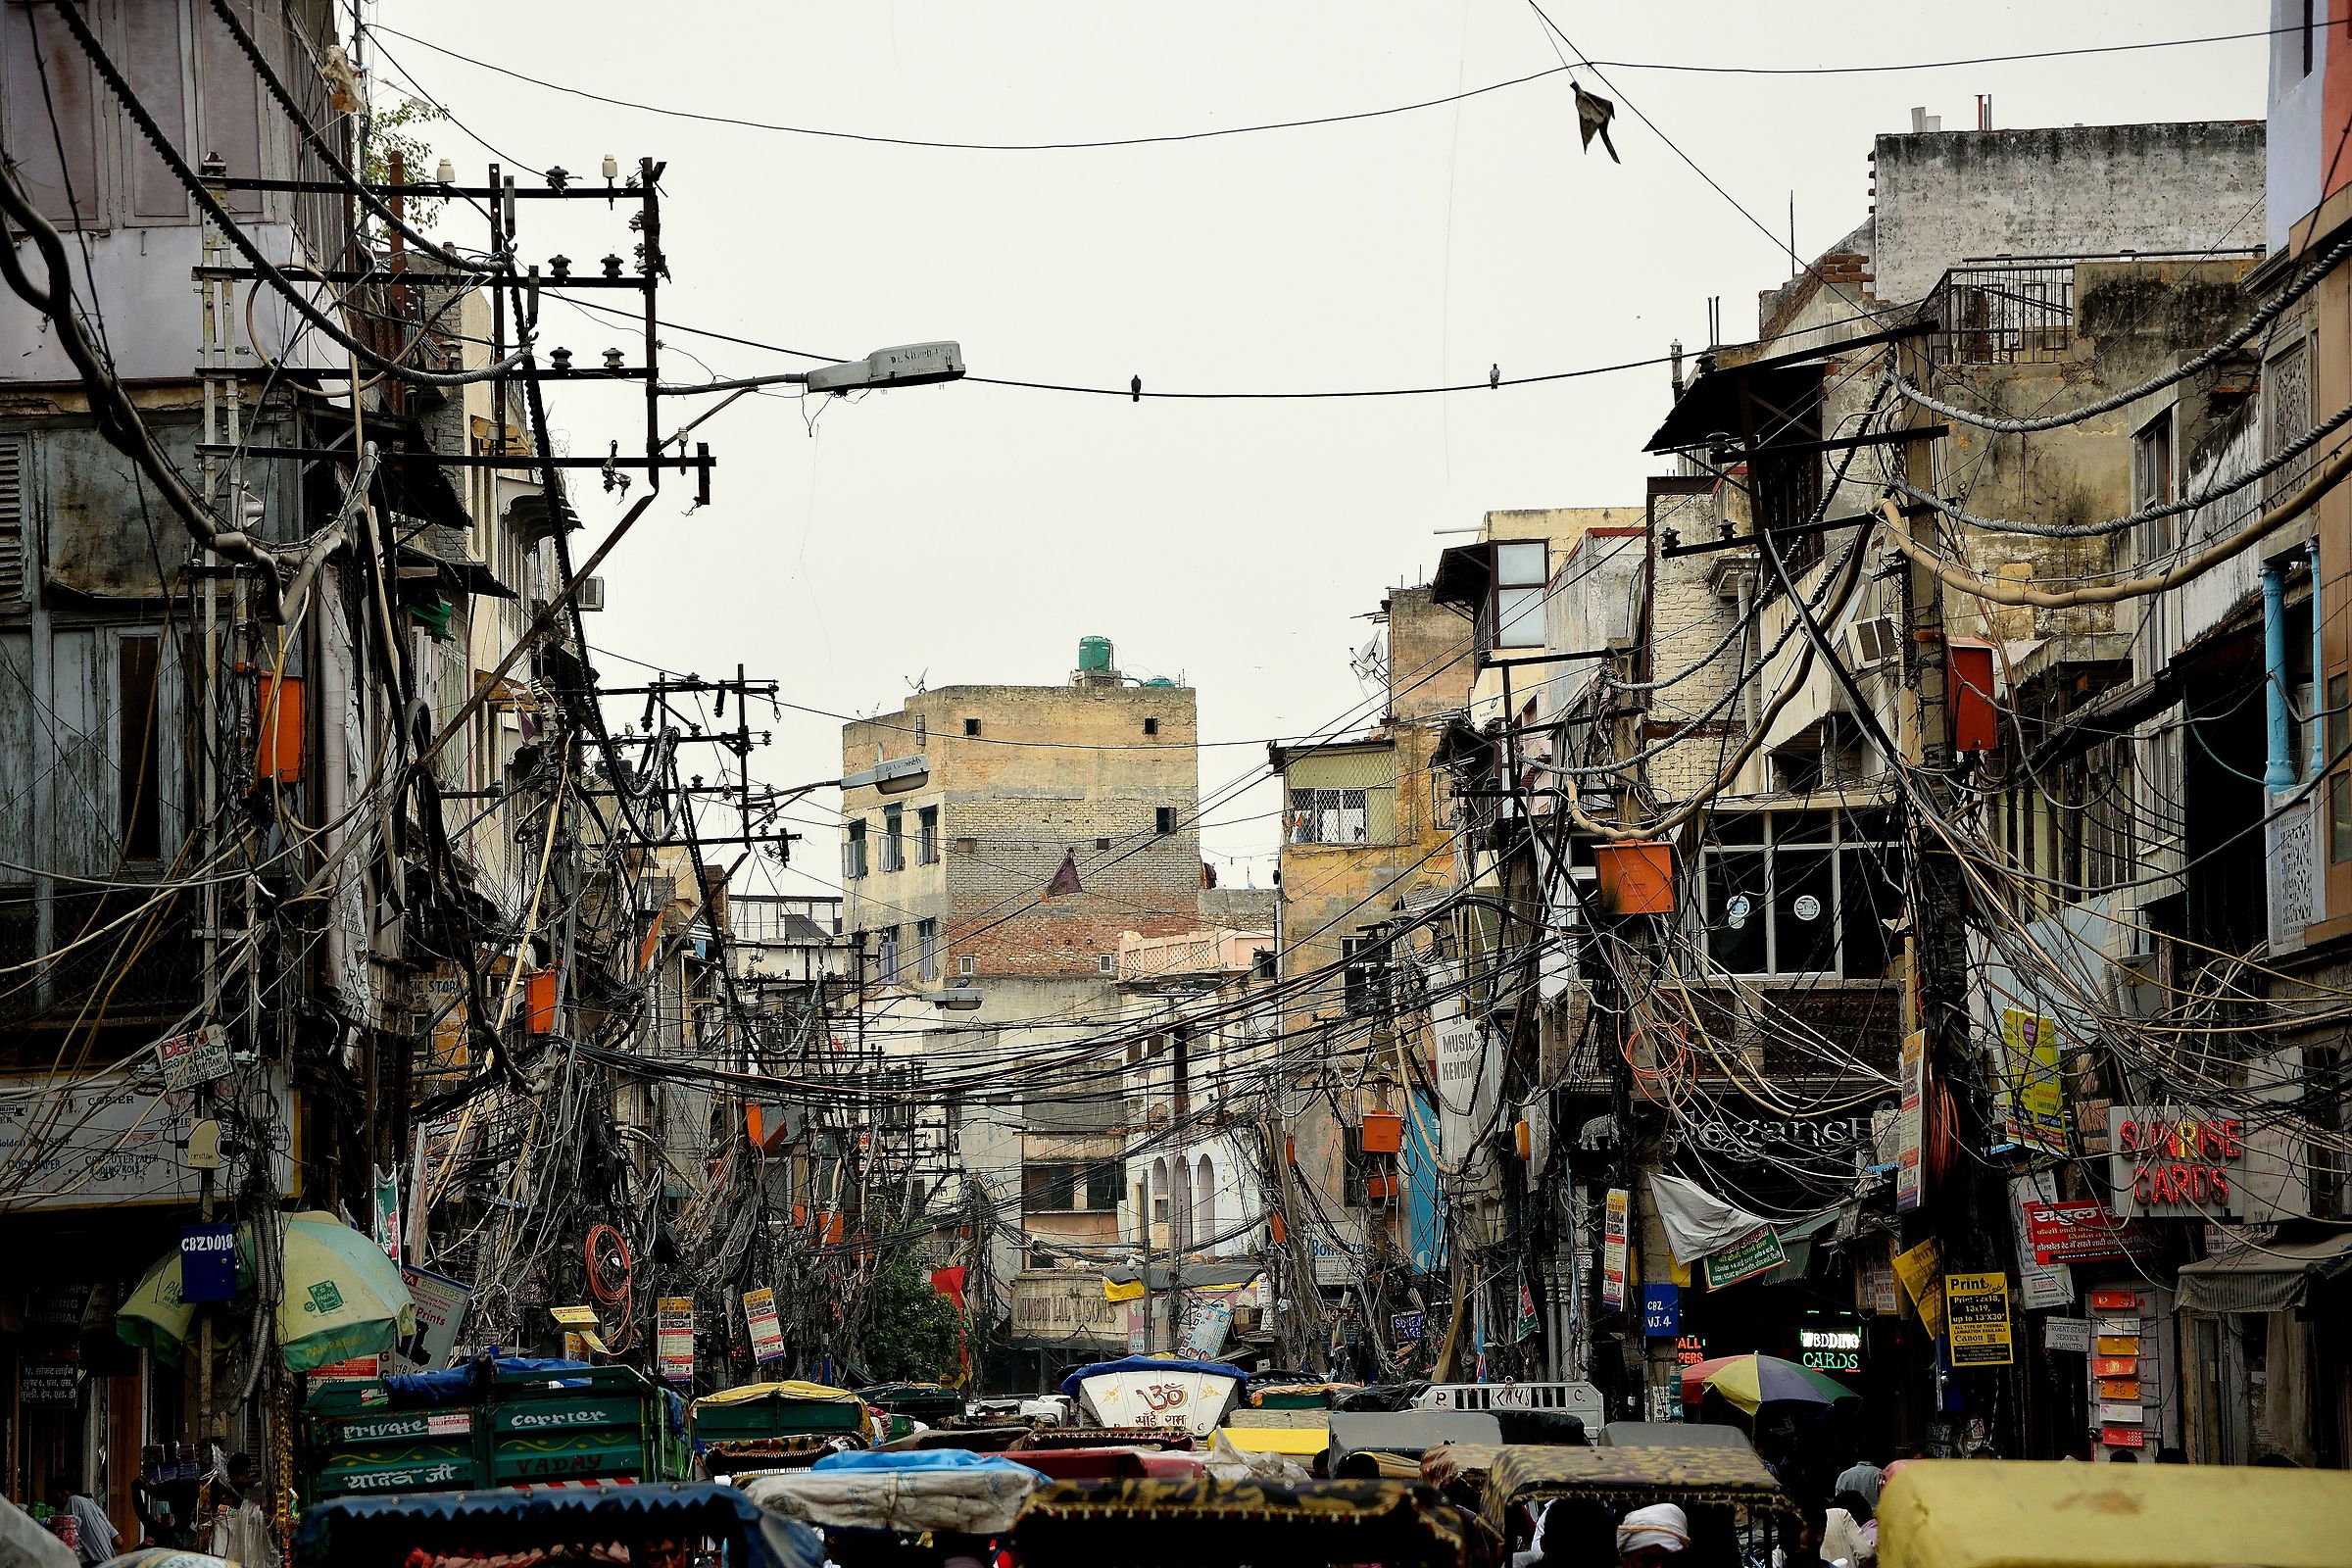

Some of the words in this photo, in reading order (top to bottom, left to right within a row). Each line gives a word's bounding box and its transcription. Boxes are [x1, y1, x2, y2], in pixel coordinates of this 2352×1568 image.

[1443, 1033, 1475, 1054] MUSIC
[2133, 1164, 2230, 1206] CARDS
[1950, 1277, 1986, 1291] Print
[416, 1306, 446, 1326] Prints
[1676, 1337, 1703, 1349] ALL
[1803, 1351, 1859, 1369] CARDS
